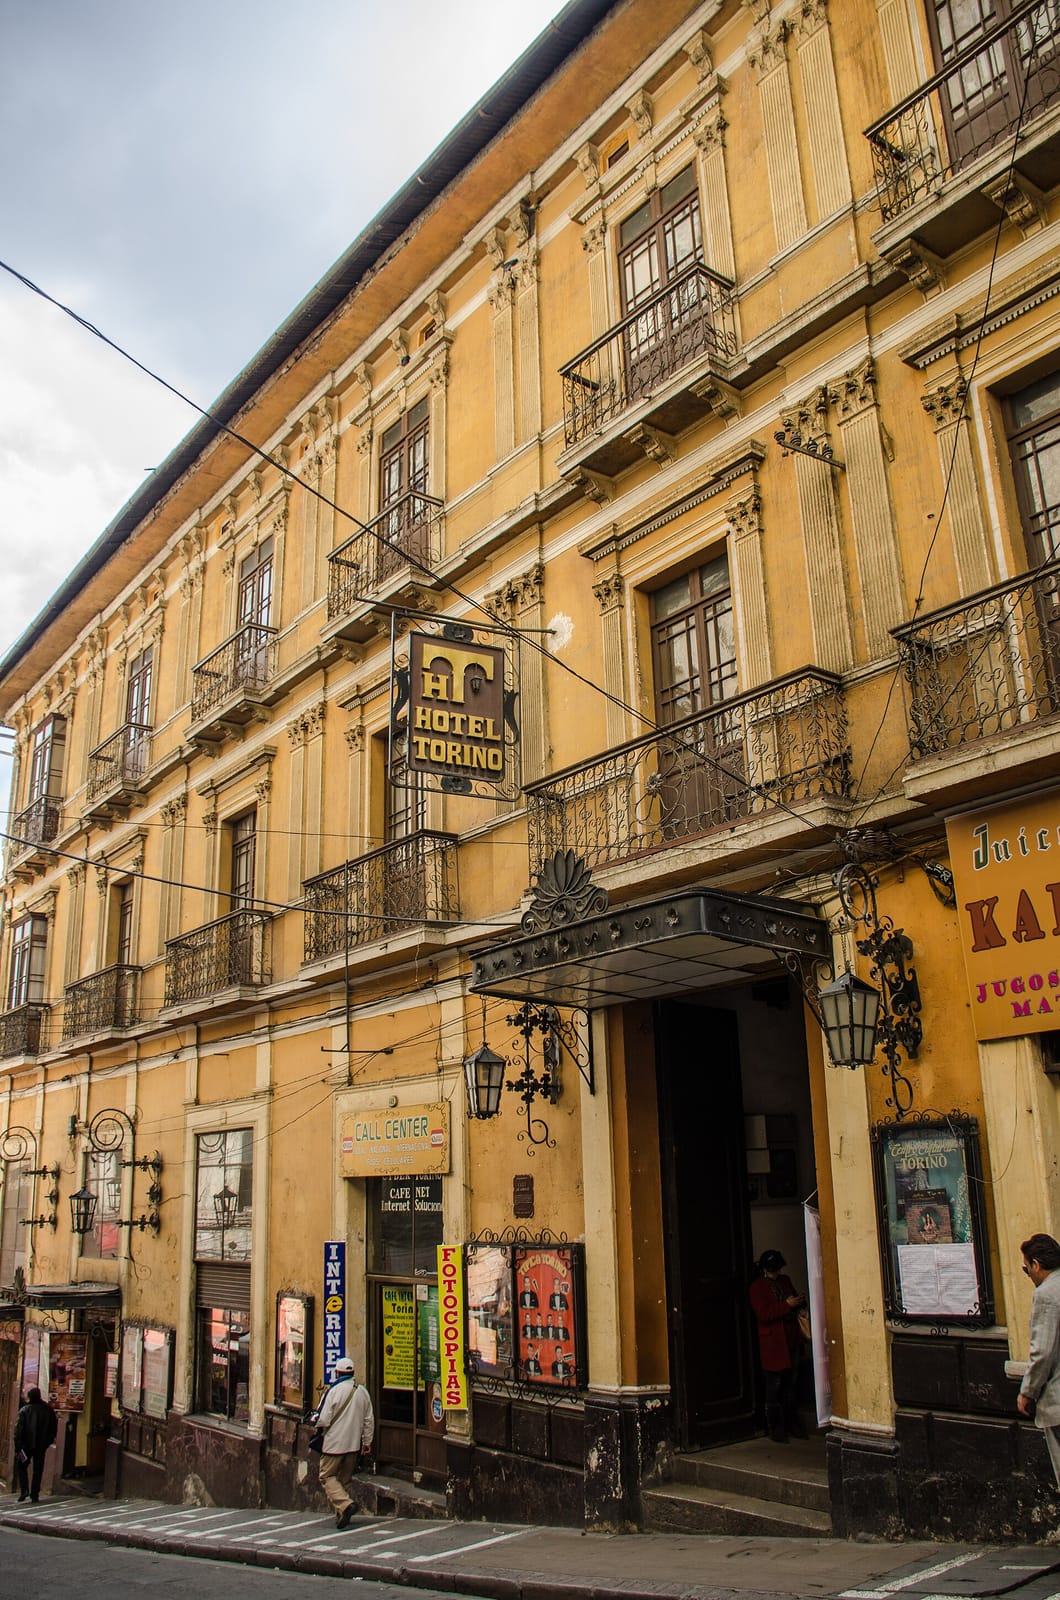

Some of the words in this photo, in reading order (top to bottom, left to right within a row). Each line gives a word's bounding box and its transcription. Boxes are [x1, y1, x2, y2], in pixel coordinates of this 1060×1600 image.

[414, 706, 501, 742] HOTEL
[412, 736, 503, 771] TORINO
[973, 823, 1060, 871] Juic
[976, 970, 1060, 1004] JUGOS
[355, 1120, 382, 1142] CALL
[384, 1116, 429, 1140] CENTER
[899, 1155, 947, 1169] TORINO
[381, 1200, 411, 1212] Internet
[389, 1187, 411, 1199] CAFE
[415, 1186, 430, 1198] NET
[541, 1253, 567, 1278] TORINO
[441, 1248, 462, 1406] FOTOCOPIAS
